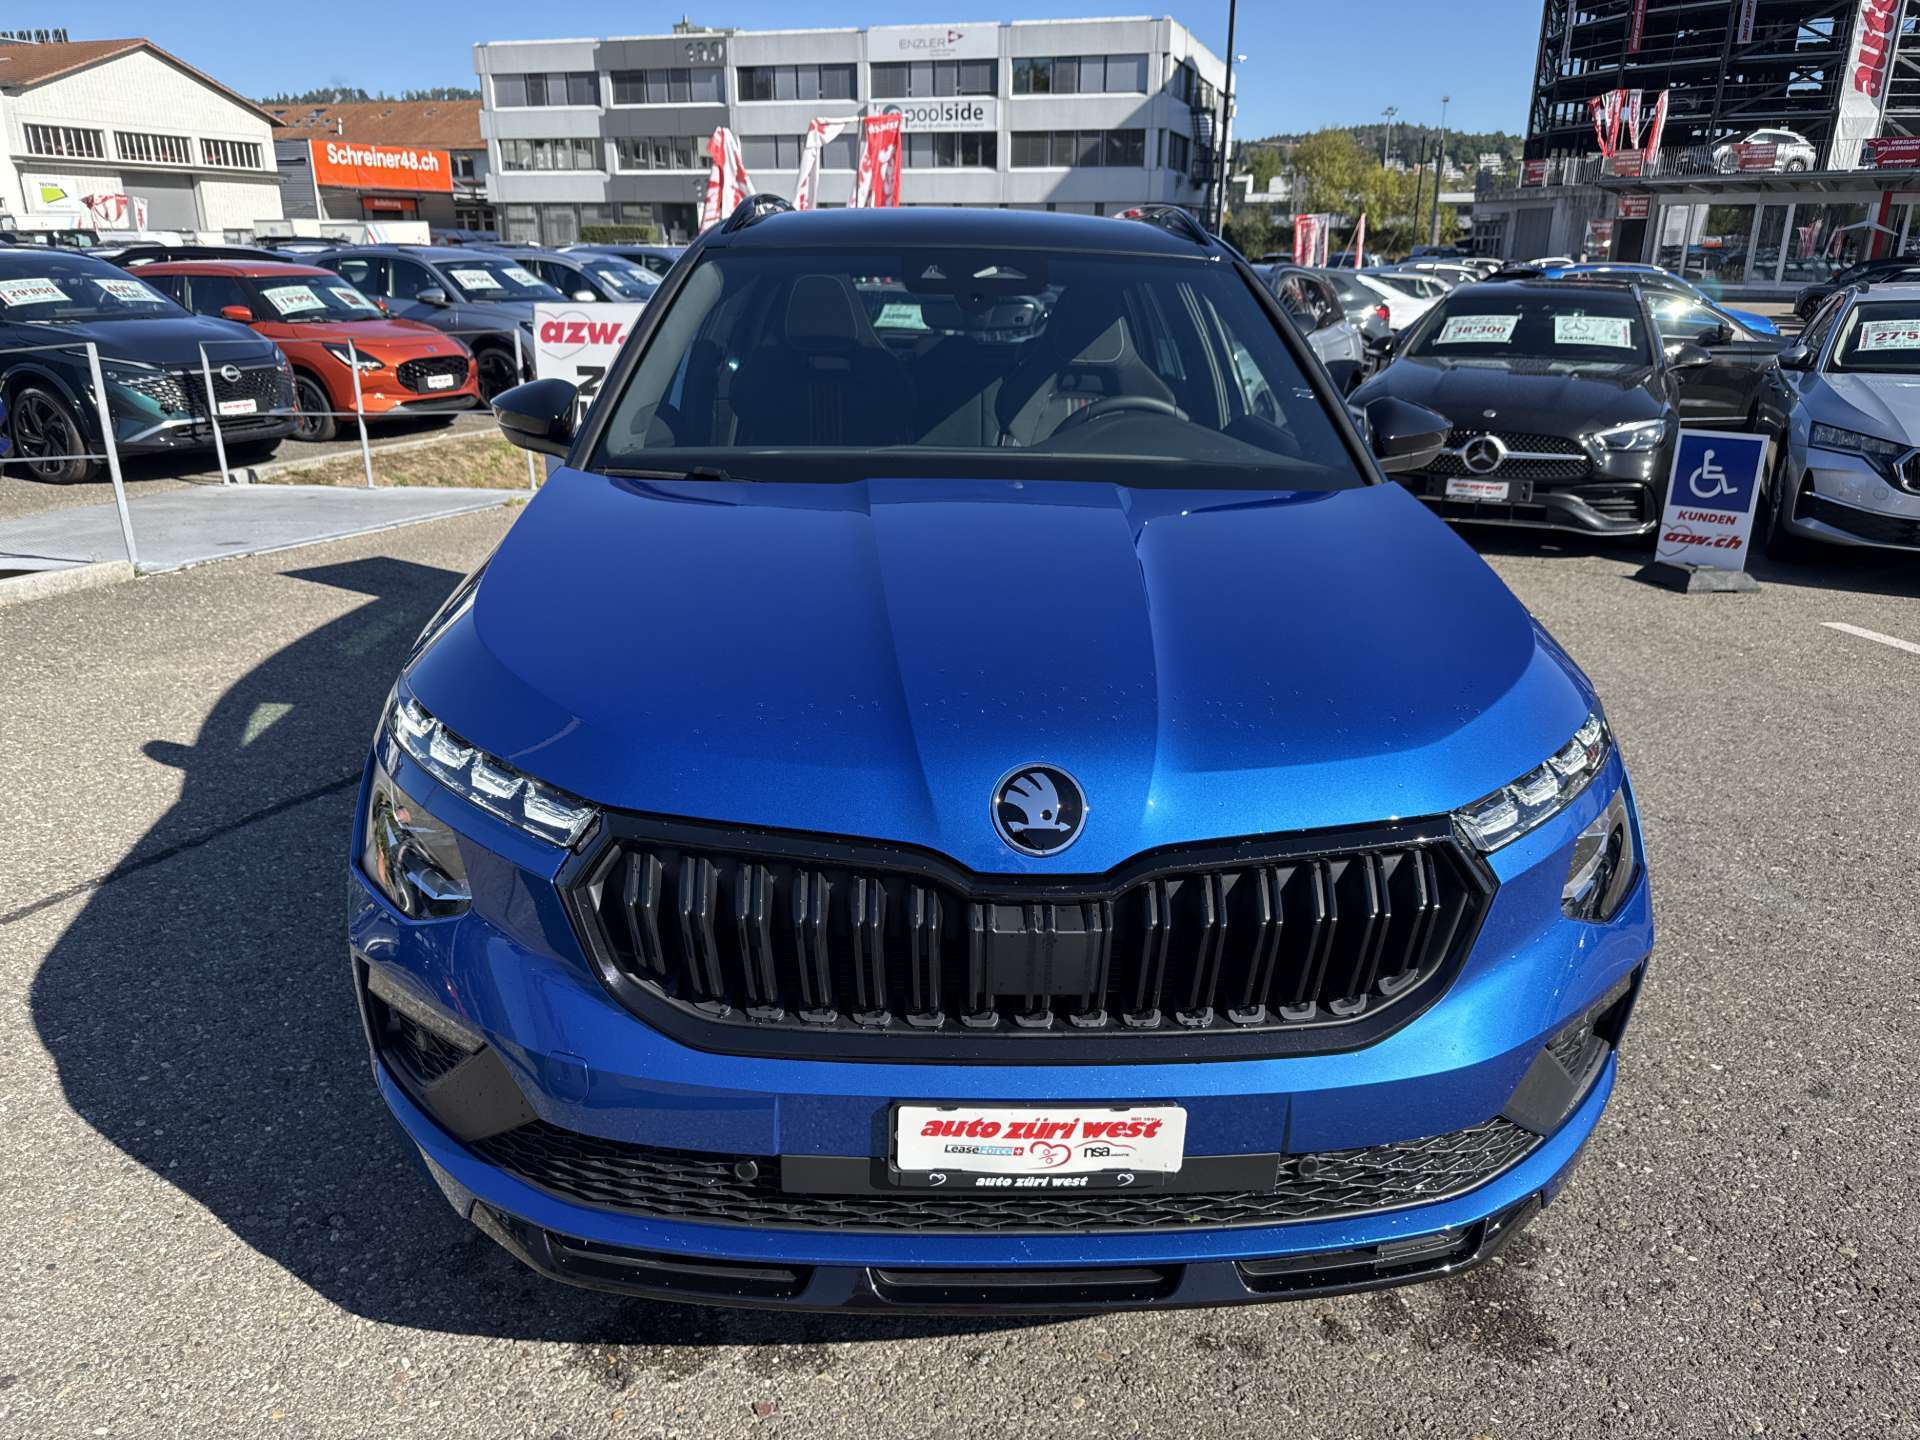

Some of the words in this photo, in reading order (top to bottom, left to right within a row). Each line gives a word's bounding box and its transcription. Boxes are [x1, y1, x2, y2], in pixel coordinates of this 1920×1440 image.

[899, 39, 946, 48] ENZLER
[905, 102, 984, 128] poolside
[326, 143, 440, 172] Schreiner48.ch
[1677, 511, 1737, 525] KUNDEN
[1663, 532, 1743, 550] azw.ch
[921, 1117, 1001, 1138] auto
[1001, 1118, 1080, 1139] züri
[1082, 1118, 1163, 1139] west
[944, 1144, 1012, 1156] LeaseForce
[1084, 1147, 1110, 1157] nsa
[976, 1176, 1012, 1187] auto
[1014, 1176, 1050, 1187] züri
[1052, 1176, 1088, 1187] west
